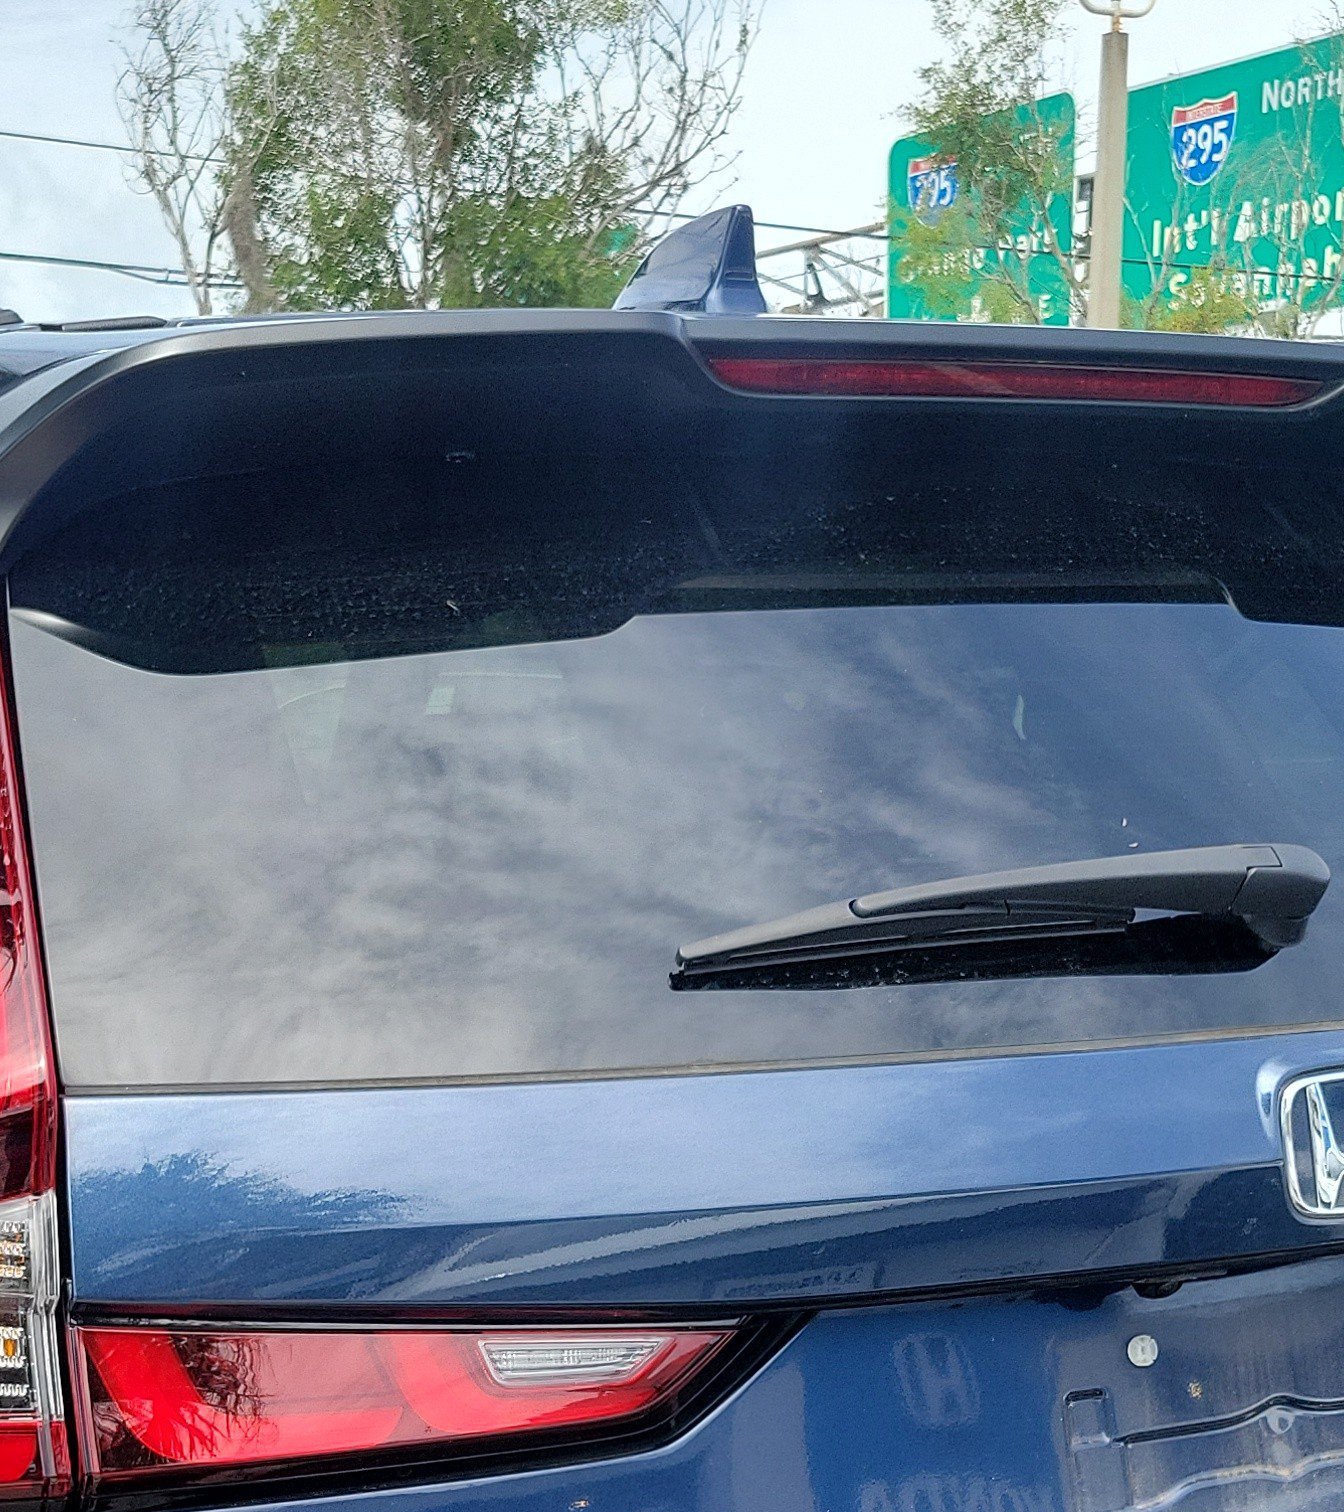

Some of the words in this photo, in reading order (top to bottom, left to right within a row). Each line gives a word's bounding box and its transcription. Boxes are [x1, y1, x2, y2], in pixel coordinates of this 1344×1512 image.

[1262, 69, 1344, 113] NORTH
[1182, 120, 1229, 168] 295
[1168, 245, 1342, 310] Sannah
